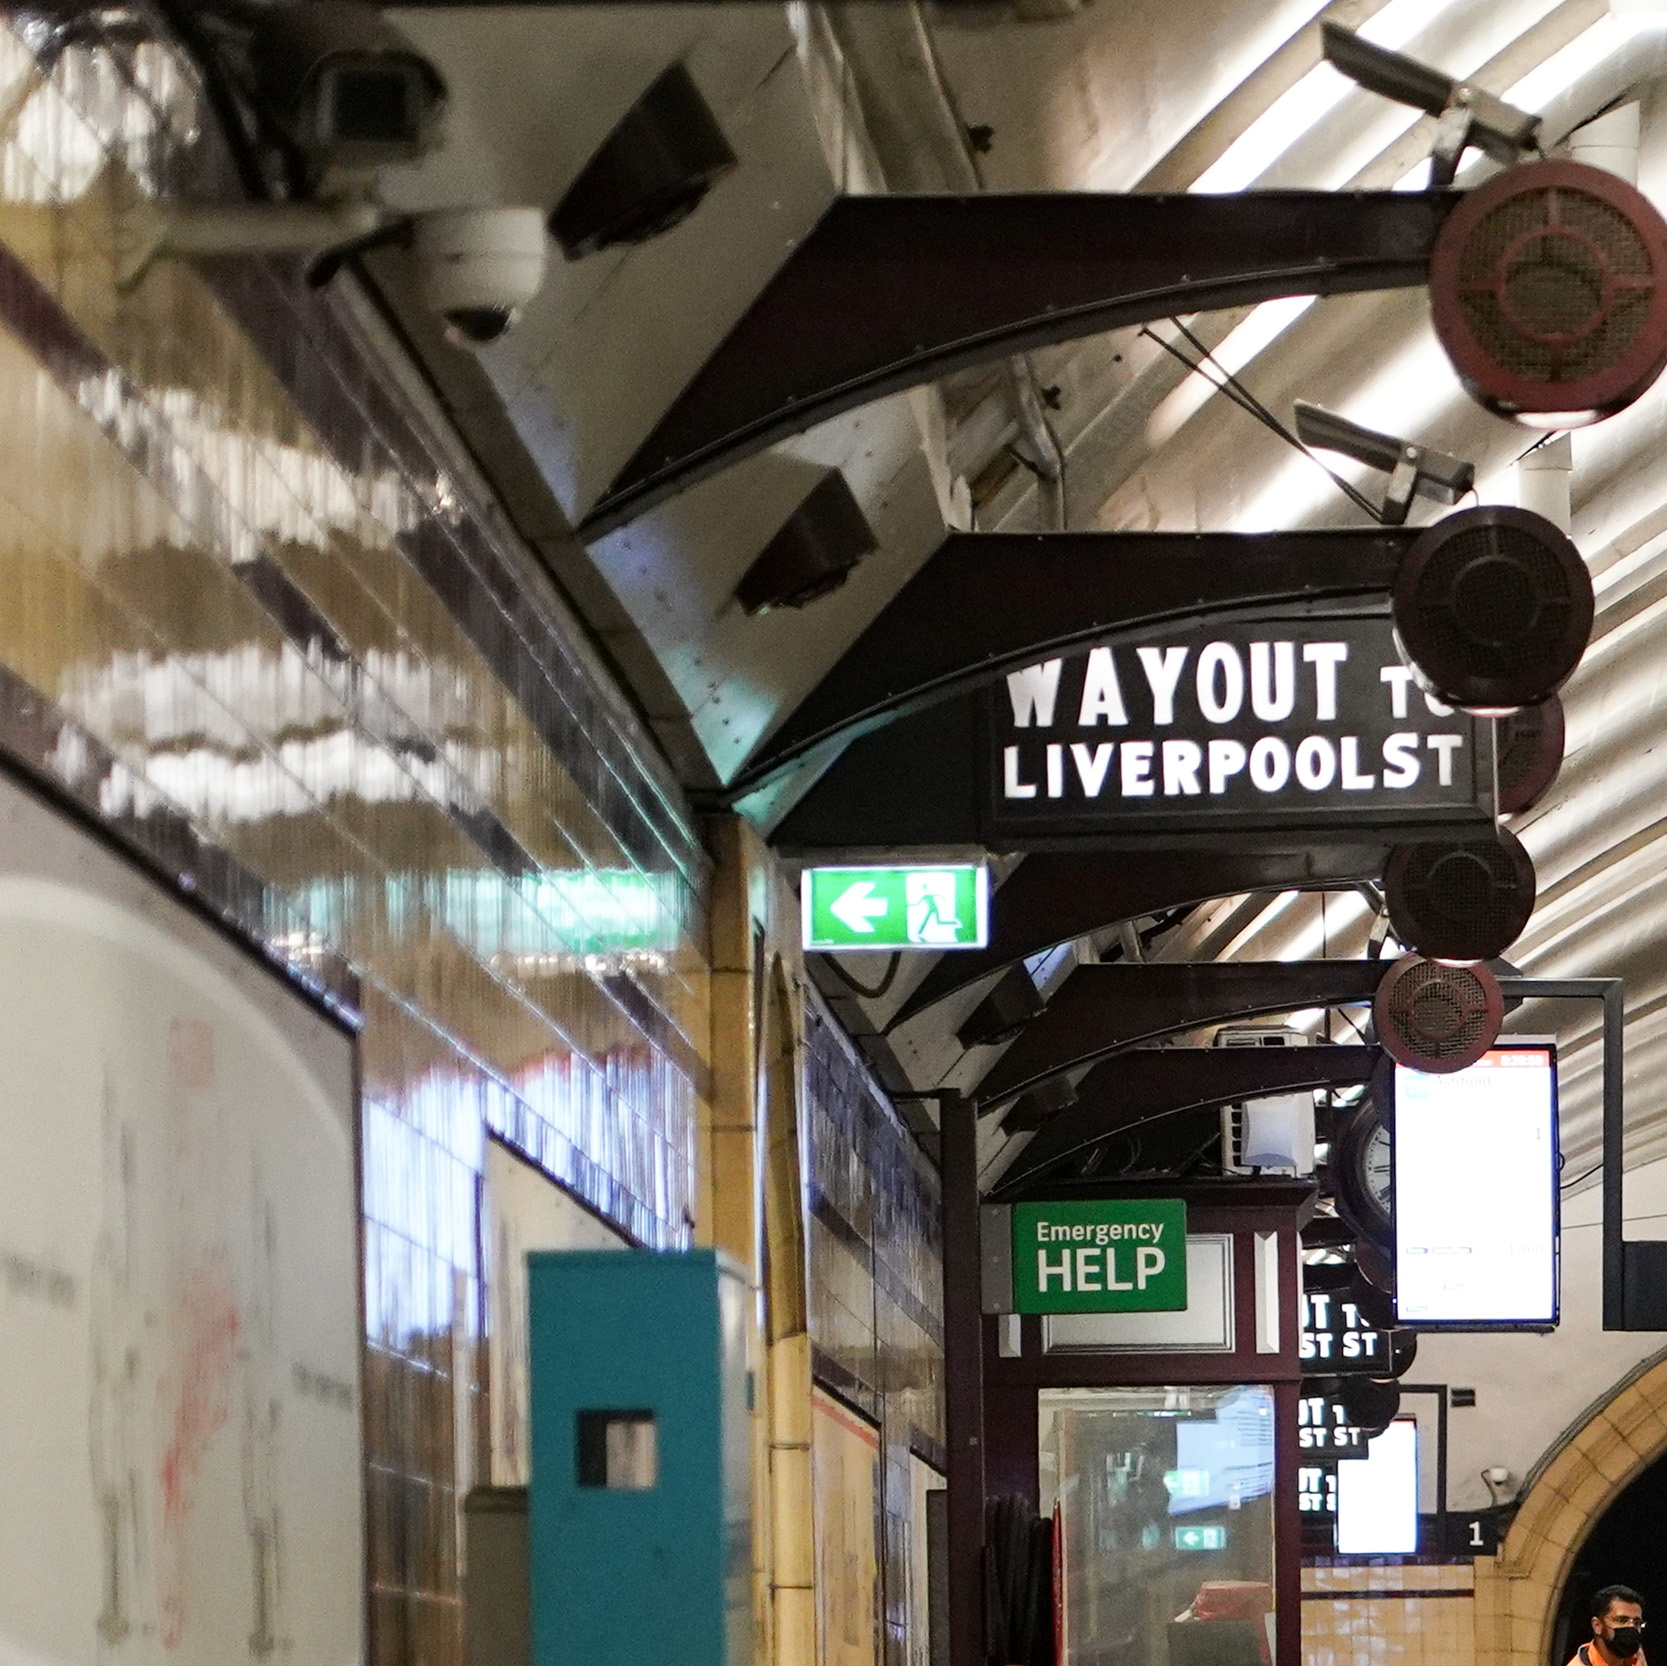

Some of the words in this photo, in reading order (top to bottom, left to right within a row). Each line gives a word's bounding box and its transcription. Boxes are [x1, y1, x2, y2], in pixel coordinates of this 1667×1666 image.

[1379, 665, 1456, 718] T
[1037, 1221, 1164, 1245] Emergency
[1037, 1246, 1166, 1292] HELP
[1341, 1331, 1378, 1358] ST
[1468, 1521, 1484, 1546] 1
